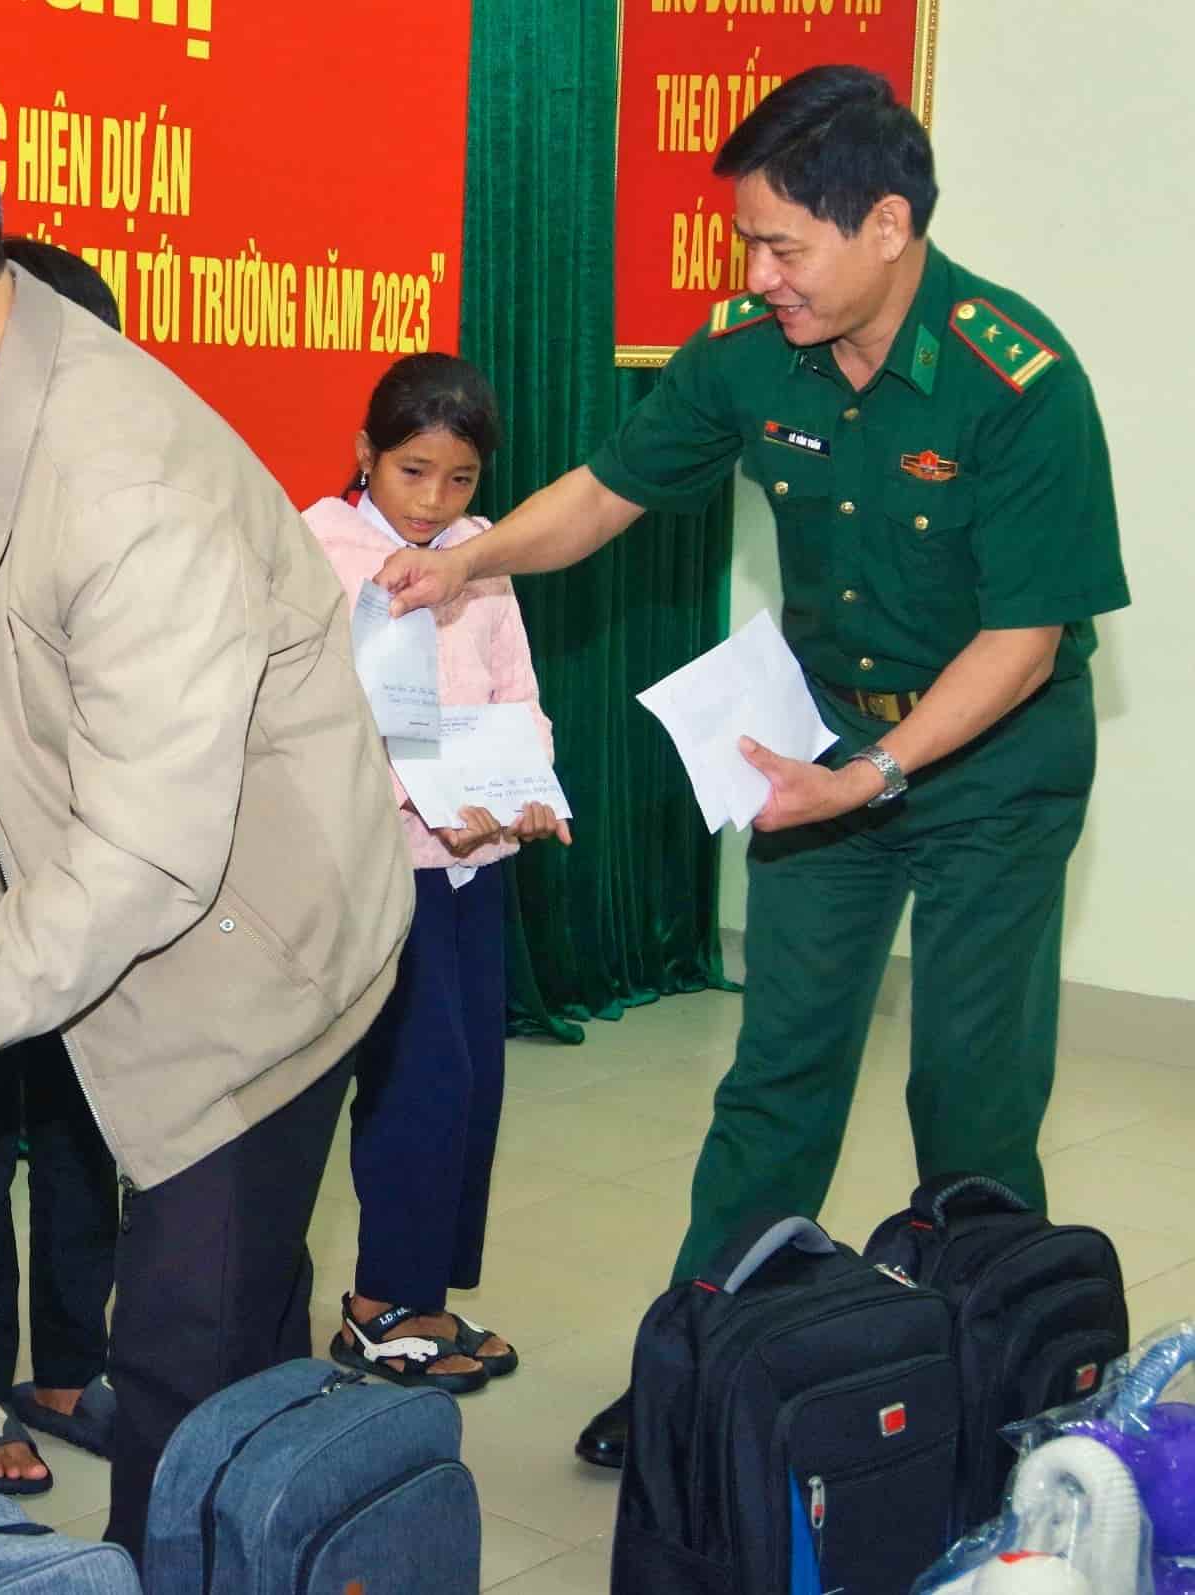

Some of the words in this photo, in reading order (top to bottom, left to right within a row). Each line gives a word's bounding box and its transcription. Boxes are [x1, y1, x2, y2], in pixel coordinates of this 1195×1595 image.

[656, 73, 721, 153] THEO
[727, 46, 782, 135] TẤ
[17, 90, 92, 227] HIỆN
[101, 110, 147, 233] DỰ
[148, 103, 192, 217] ÁN
[136, 233, 181, 343] TỚI
[189, 238, 297, 348] TRƯỜNG
[304, 248, 364, 351] NĂM
[671, 196, 723, 291] BÁC
